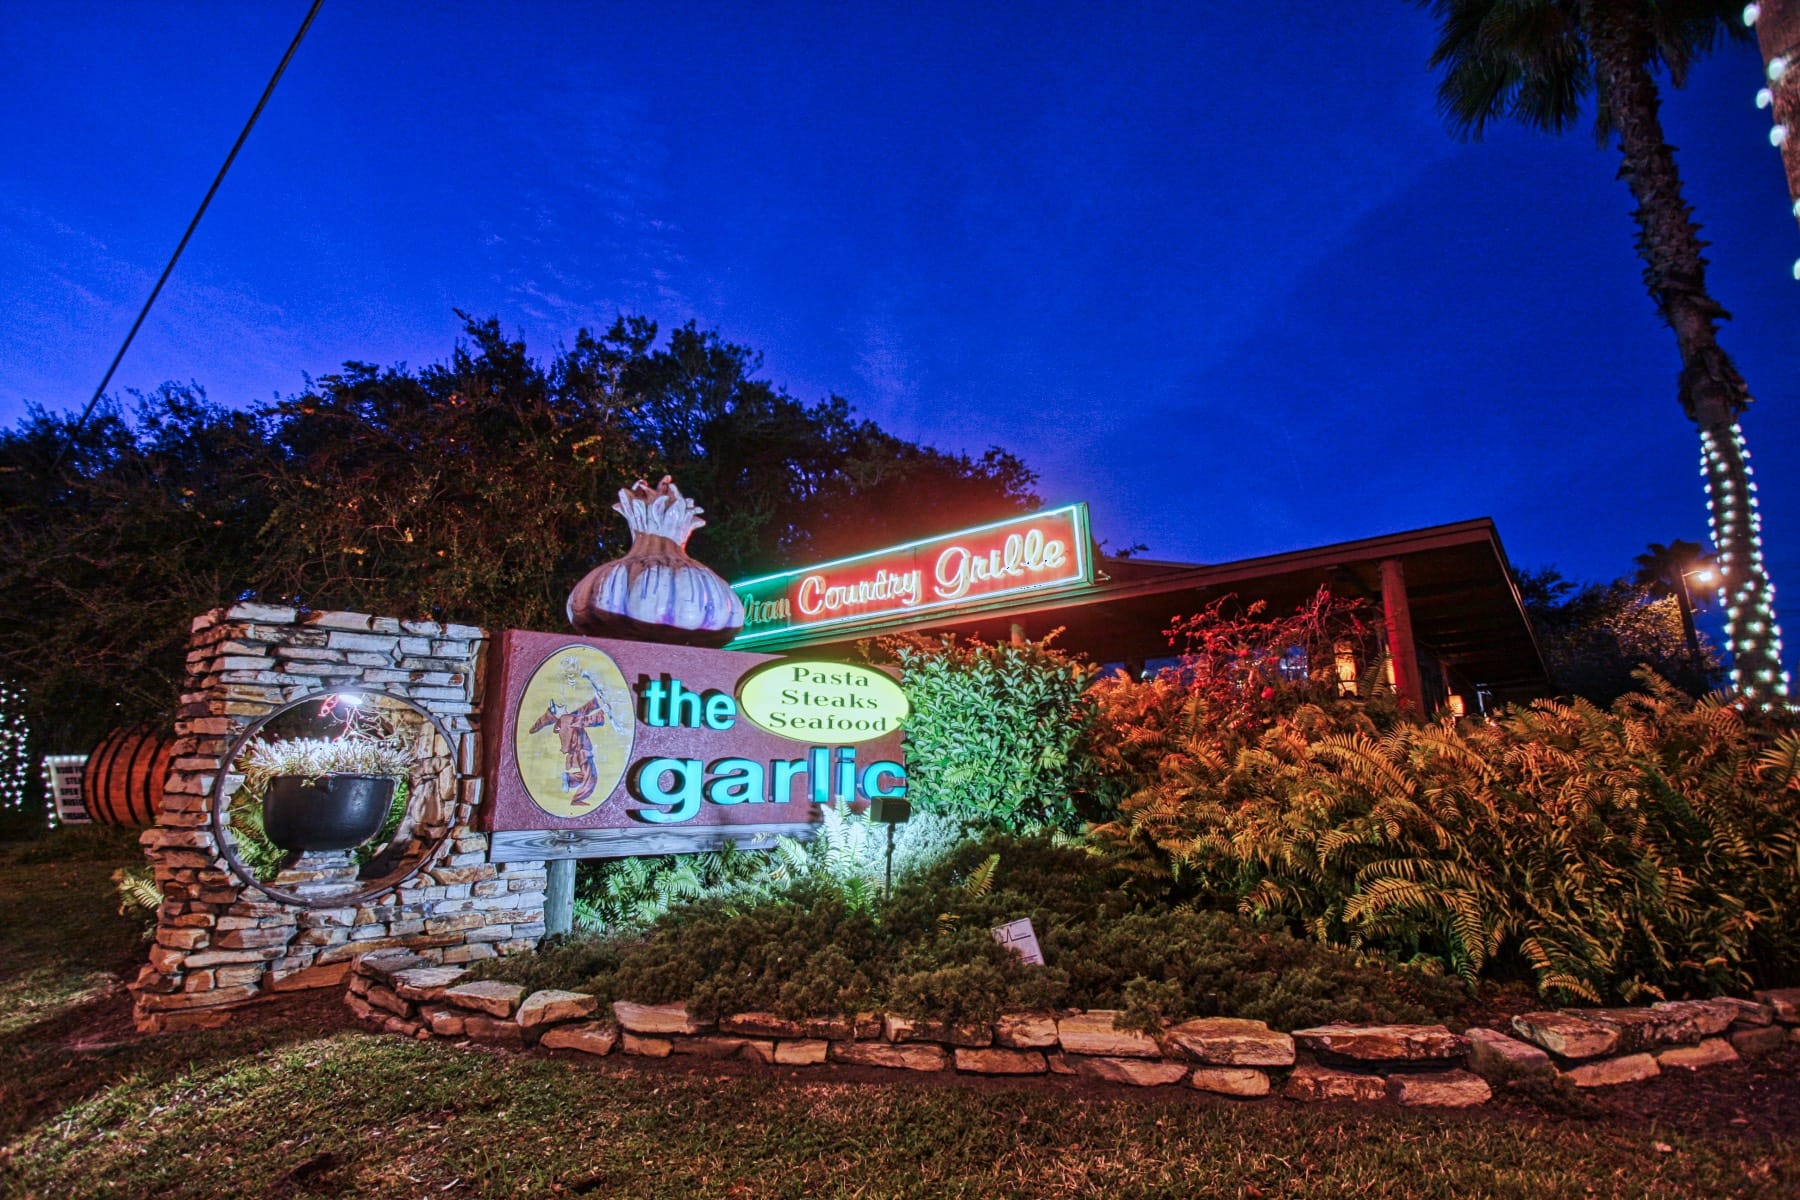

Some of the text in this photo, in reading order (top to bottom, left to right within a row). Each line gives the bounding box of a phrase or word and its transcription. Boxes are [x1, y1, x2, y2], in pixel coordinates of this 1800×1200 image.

[798, 569, 922, 615] Country
[933, 528, 1066, 599] Grille
[791, 666, 869, 687] Pasta
[642, 677, 737, 731] the
[781, 689, 878, 709] Steaks
[769, 711, 888, 731] Seafood
[637, 746, 907, 824] garlic
